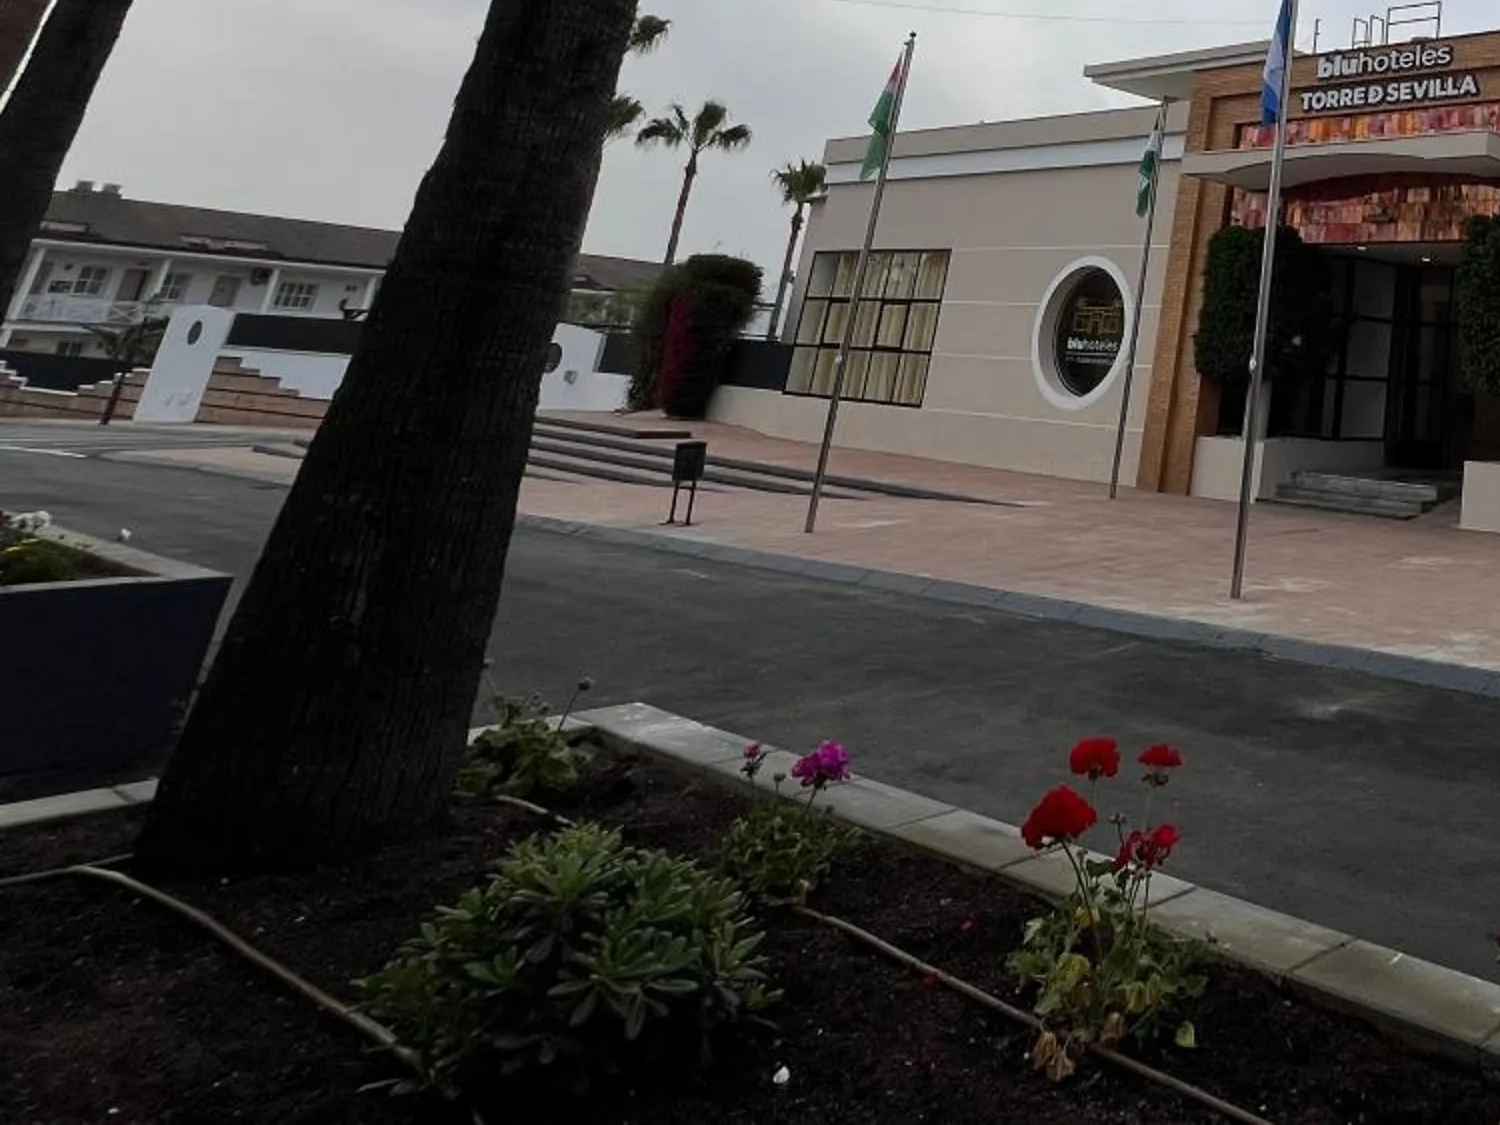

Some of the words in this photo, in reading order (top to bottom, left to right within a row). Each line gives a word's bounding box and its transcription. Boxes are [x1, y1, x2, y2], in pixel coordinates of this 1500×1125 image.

[1317, 45, 1451, 78] bluhoteles
[1300, 86, 1366, 110] TORRE
[1385, 75, 1478, 102] SEVILLA
